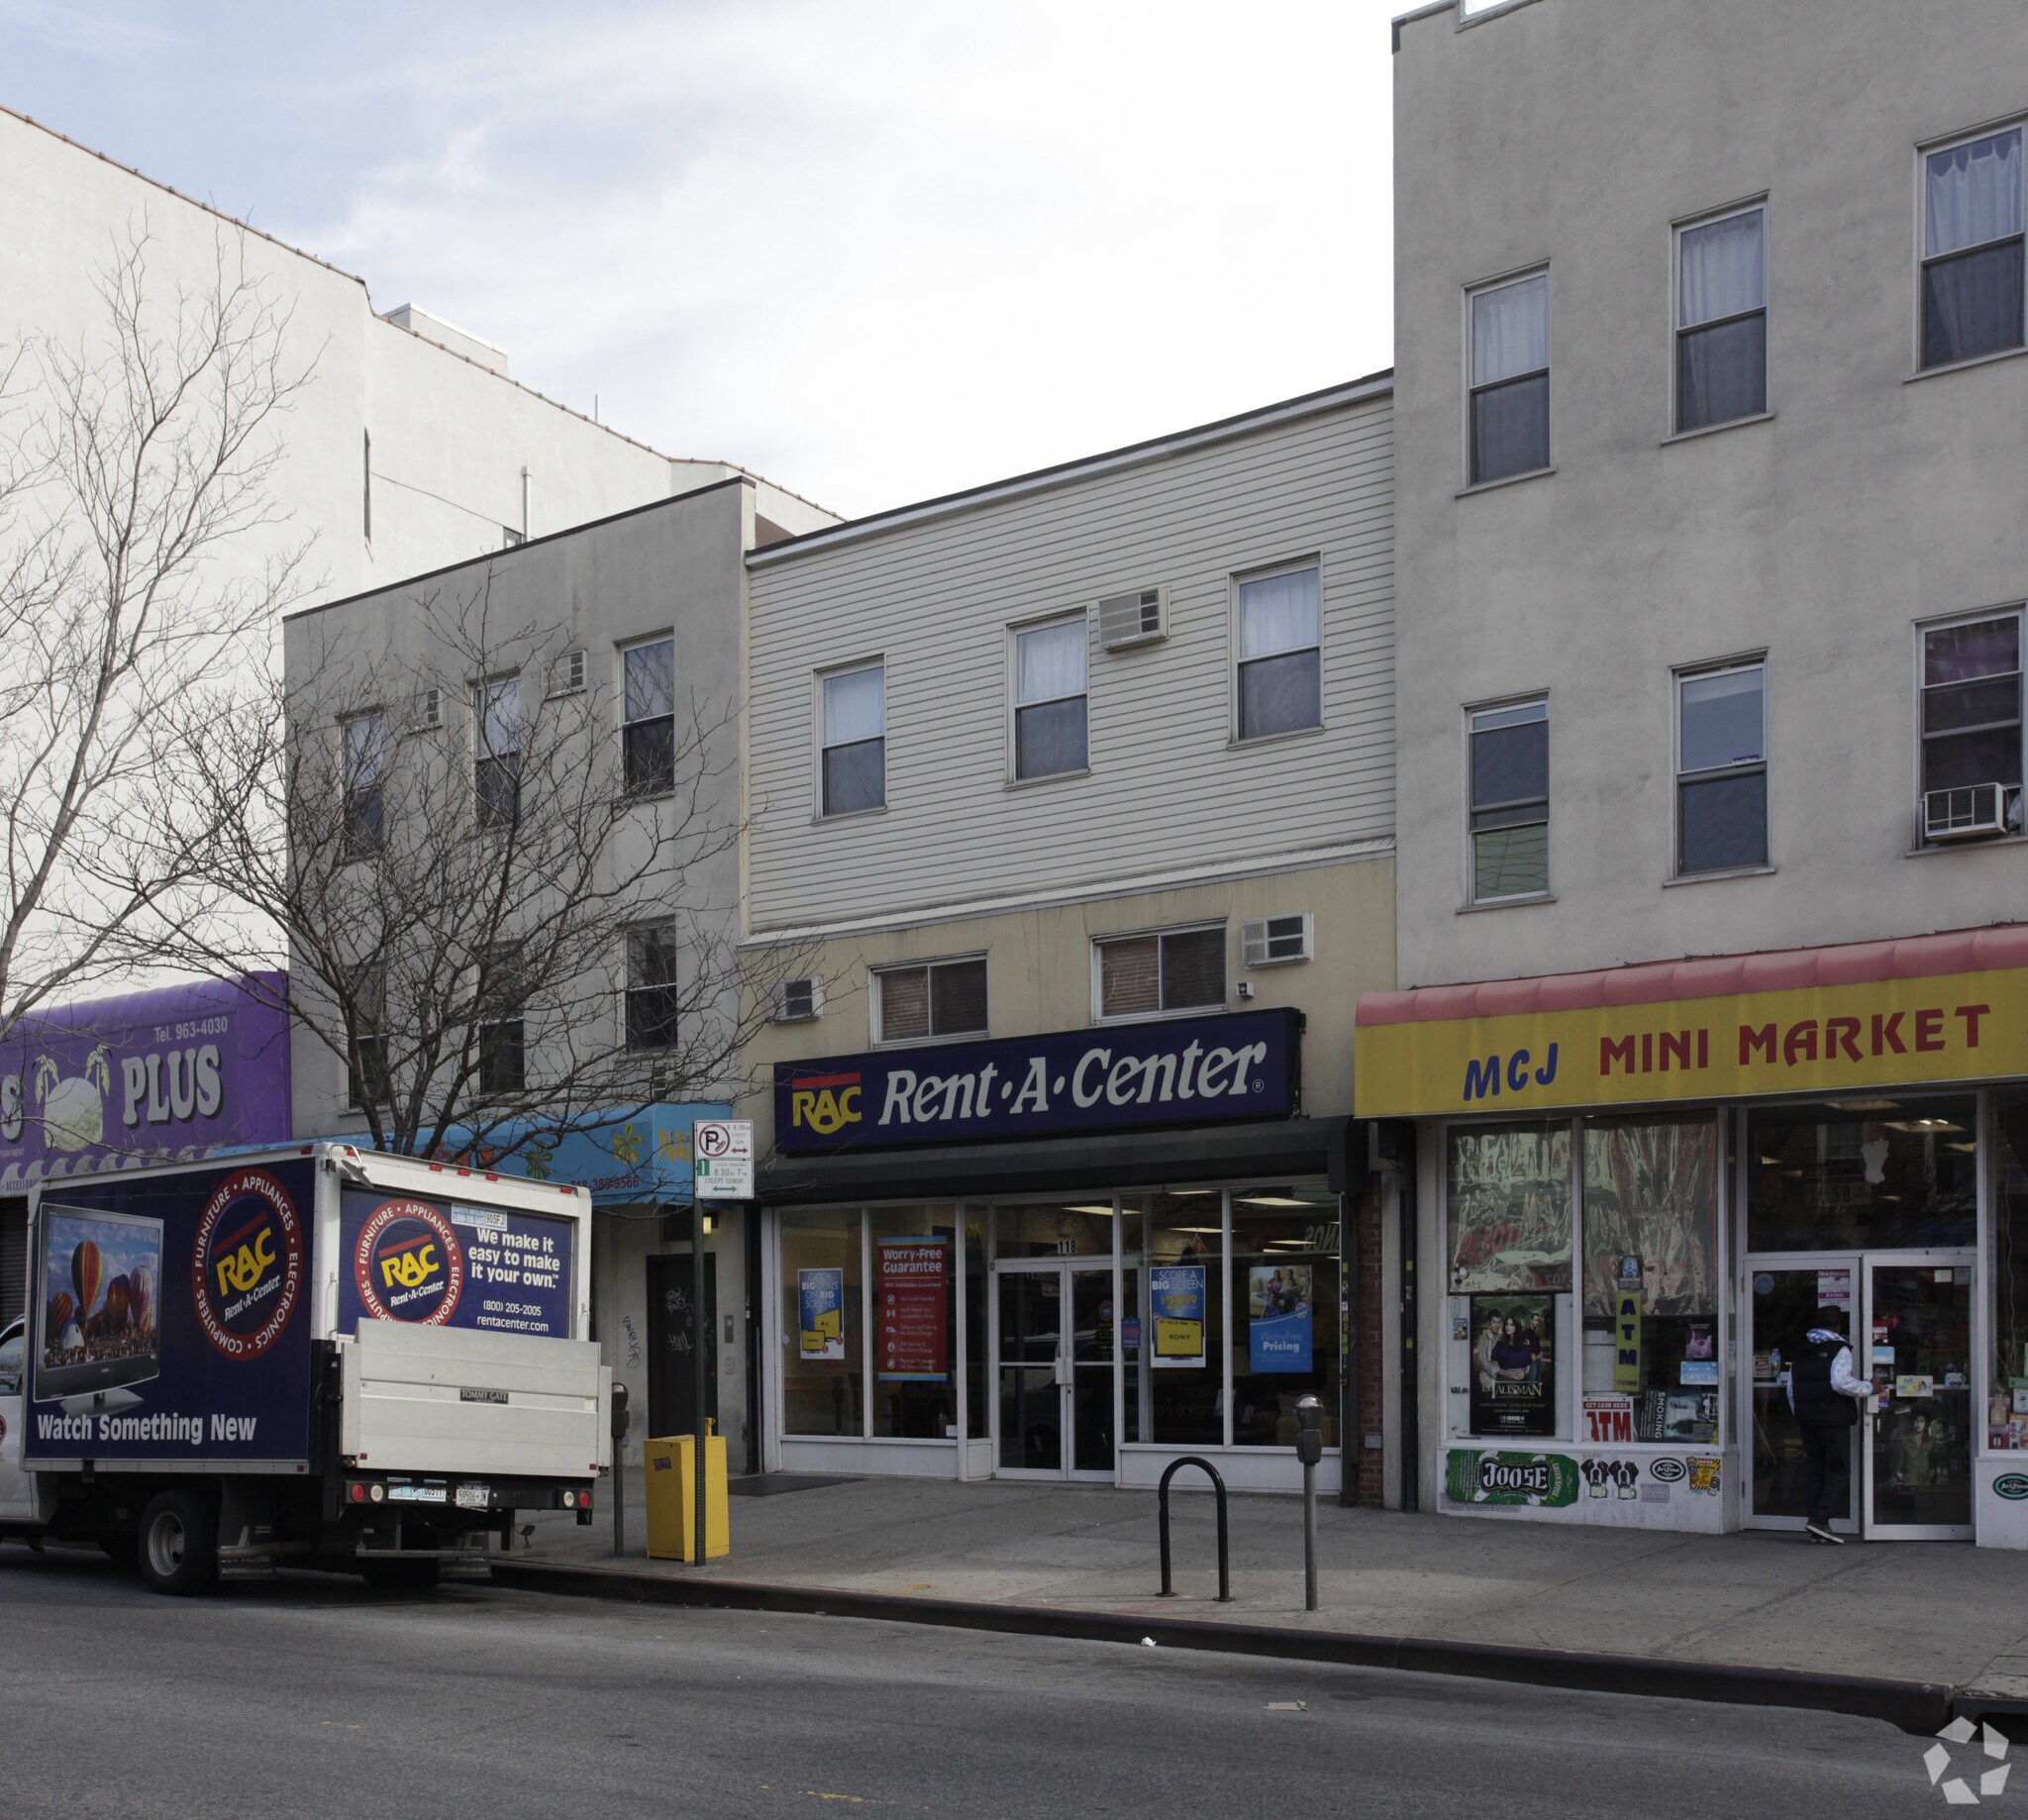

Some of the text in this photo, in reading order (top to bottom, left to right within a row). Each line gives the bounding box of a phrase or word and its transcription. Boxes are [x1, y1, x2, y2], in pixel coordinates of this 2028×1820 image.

[154, 1016, 229, 1043] Tel. 963-4030
[1463, 1004, 1991, 1101] MCJ MINI MARKET
[121, 1045, 223, 1128] PLUS
[792, 1085, 862, 1135] RAC
[242, 1175, 294, 1232] APPLIANCES
[195, 1186, 231, 1268] FURNITURE
[358, 1206, 394, 1264] FURNITURE
[405, 1203, 456, 1253] APPLIANCES
[476, 1227, 555, 1254] We make it
[468, 1247, 560, 1271] easy to make
[883, 1248, 943, 1261] Worry-Free
[1058, 1239, 1077, 1255] 118
[216, 1227, 276, 1297] RAC
[380, 1244, 440, 1288] RAC
[471, 1263, 483, 1279] it
[487, 1267, 520, 1284] your
[883, 1261, 943, 1273] Guarantee
[1159, 1270, 1197, 1280] SCORE A
[422, 1265, 459, 1326] ELECTRONIC
[801, 1281, 816, 1290] BIG
[1152, 1279, 1204, 1290] BIG SCREEN
[255, 1252, 299, 1350] ELECTRONICS
[483, 1299, 542, 1317] (800) 205-2005
[805, 1299, 836, 1308] SCREENS
[196, 1289, 244, 1354] COMPUTERS
[476, 1316, 550, 1333] rentacenter.com
[1618, 1298, 1637, 1365] ATM
[1263, 1340, 1300, 1354] Pricing
[461, 1389, 508, 1402] TOMMY GATE
[1655, 1391, 1666, 1439] SMOKING
[38, 1412, 257, 1446] Watch Something New
[1482, 1463, 1548, 1488] JOOSE
